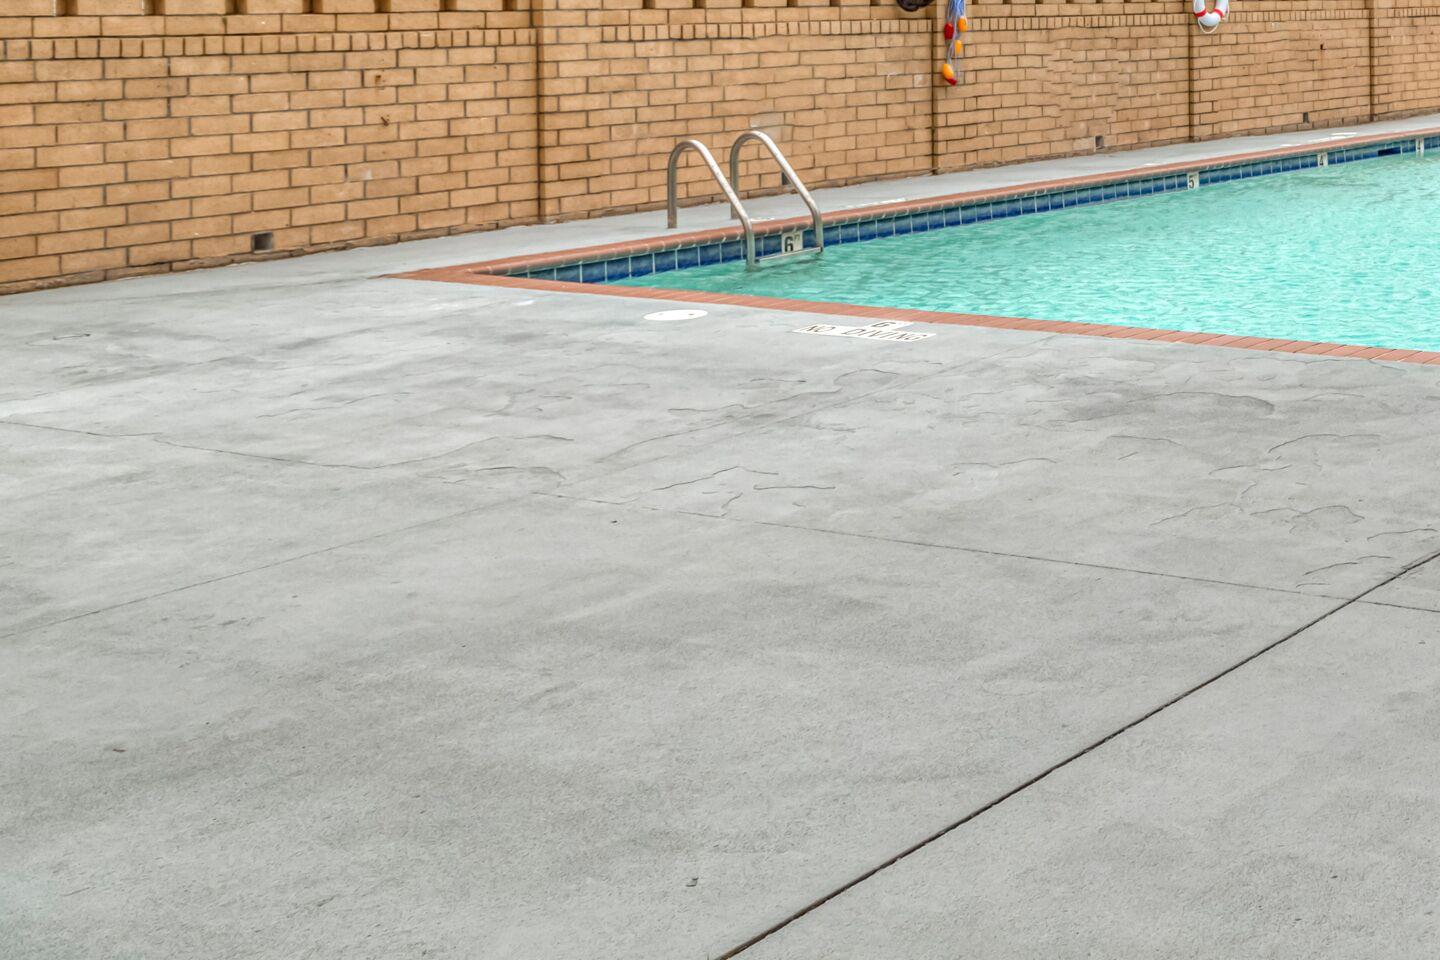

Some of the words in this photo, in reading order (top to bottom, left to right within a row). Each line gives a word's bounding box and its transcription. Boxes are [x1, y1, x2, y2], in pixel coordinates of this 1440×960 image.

[1188, 174, 1195, 189] 5
[784, 236, 794, 253] 6
[800, 325, 837, 333] NO
[841, 328, 928, 341] DIVING
